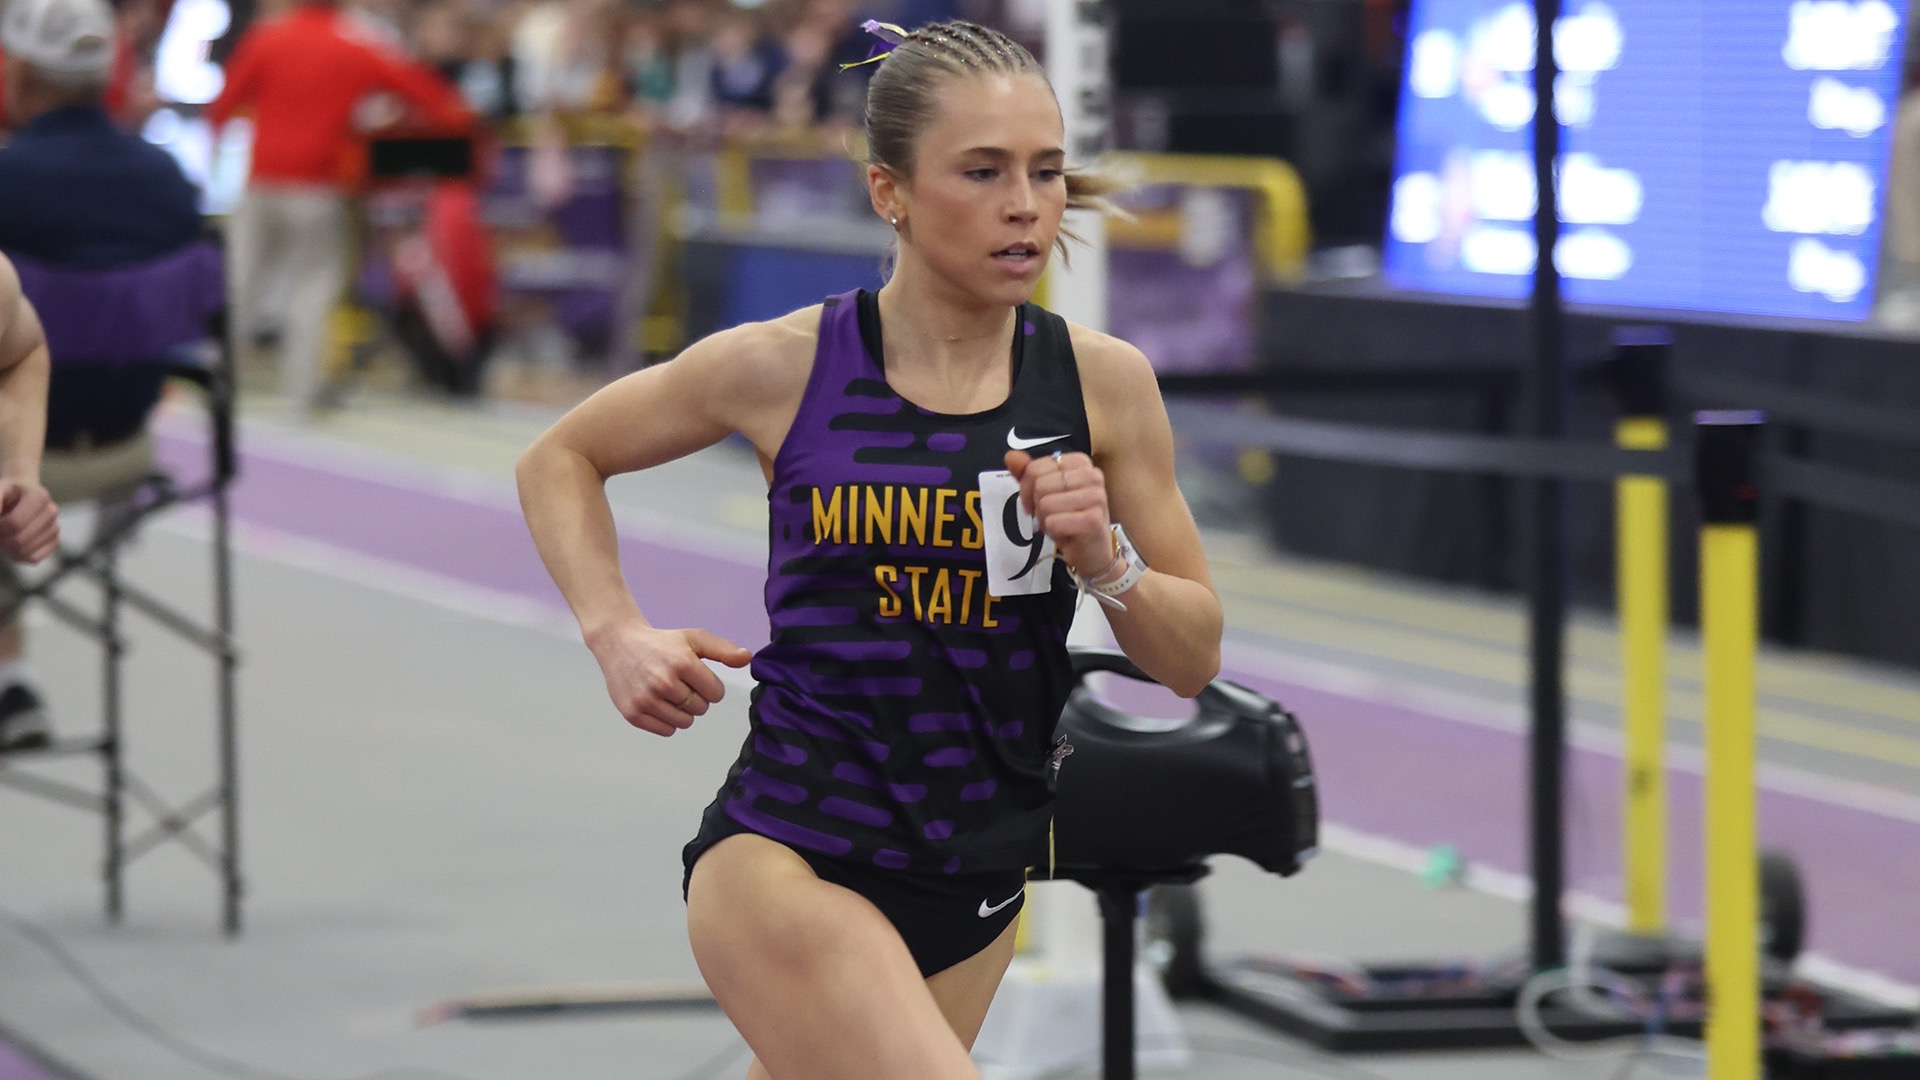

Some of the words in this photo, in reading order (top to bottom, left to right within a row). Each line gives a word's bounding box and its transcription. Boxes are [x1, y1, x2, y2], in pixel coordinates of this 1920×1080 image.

[812, 485, 984, 549] MINNES
[1002, 490, 1045, 581] 9
[874, 565, 1001, 628] STATE
